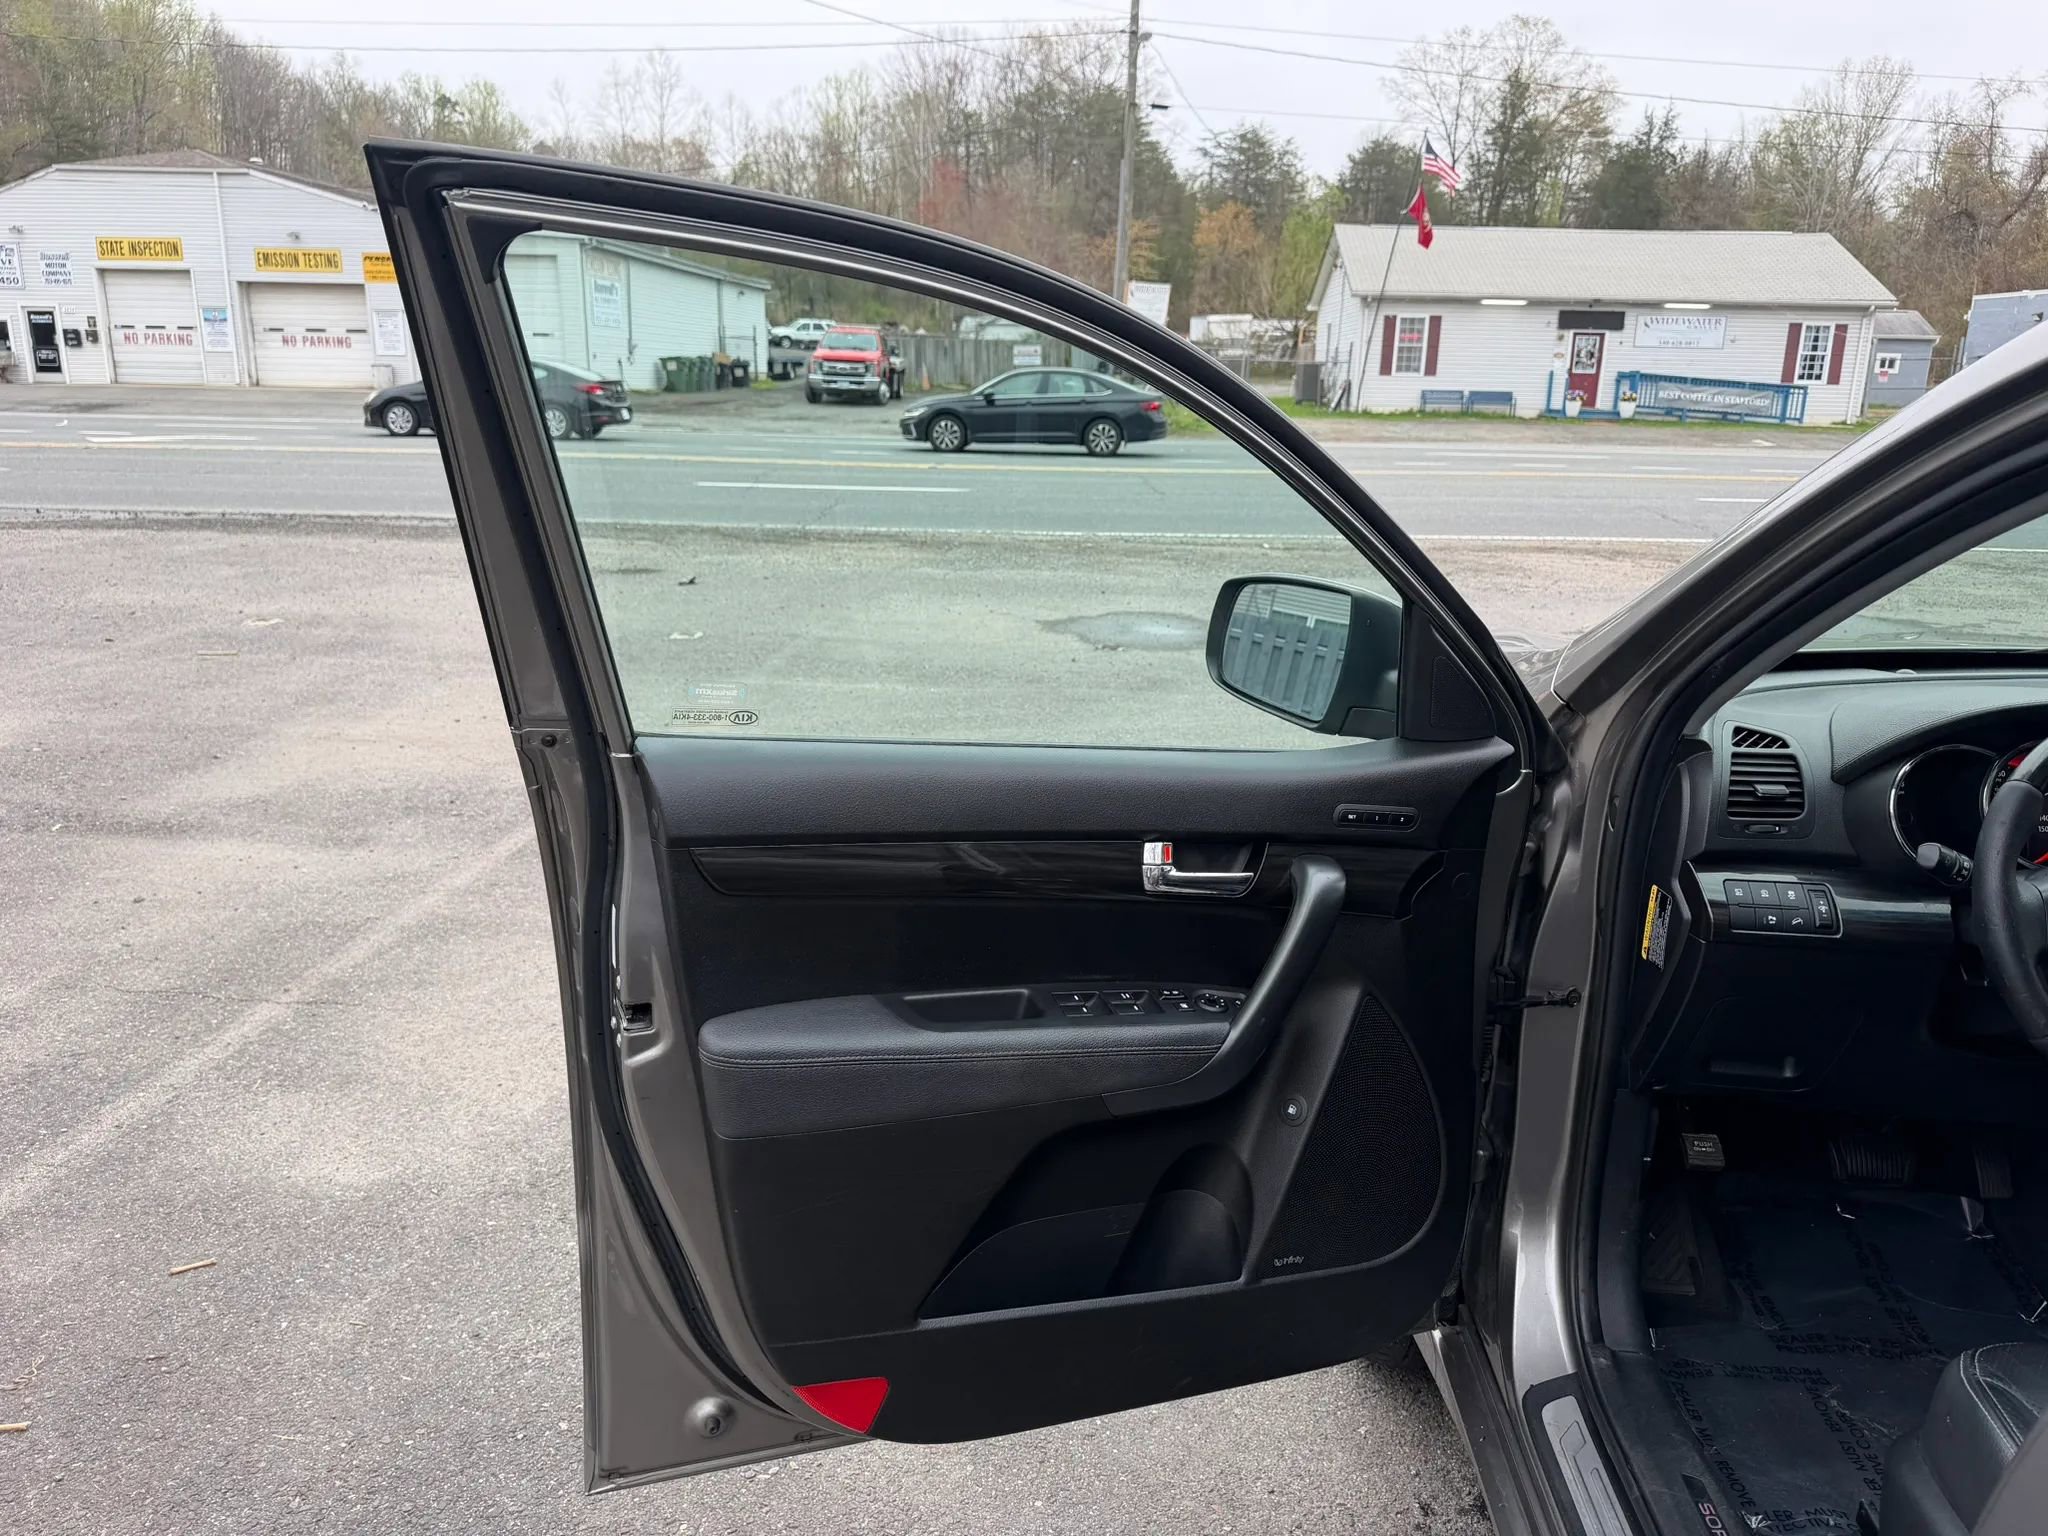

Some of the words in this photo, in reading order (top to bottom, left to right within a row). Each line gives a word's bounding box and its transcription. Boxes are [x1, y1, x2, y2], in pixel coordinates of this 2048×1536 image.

[99, 240, 125, 257] STATE
[128, 240, 180, 257] INSPECTION
[256, 252, 300, 268] EMISSION
[302, 252, 339, 268] TESTING
[123, 333, 139, 345] NO
[144, 332, 193, 346] PARKING
[281, 335, 297, 347] NO
[302, 336, 352, 349] PARKING
[1658, 389, 1681, 400] BEST
[1681, 391, 1713, 402] COFFEE
[1713, 394, 1724, 403] IN
[1804, 1384, 1844, 1432] REMOVE
[1837, 1439, 1869, 1472] MUST
[1714, 1459, 1757, 1509] REMOVE
[1804, 1507, 1850, 1521] MUST
